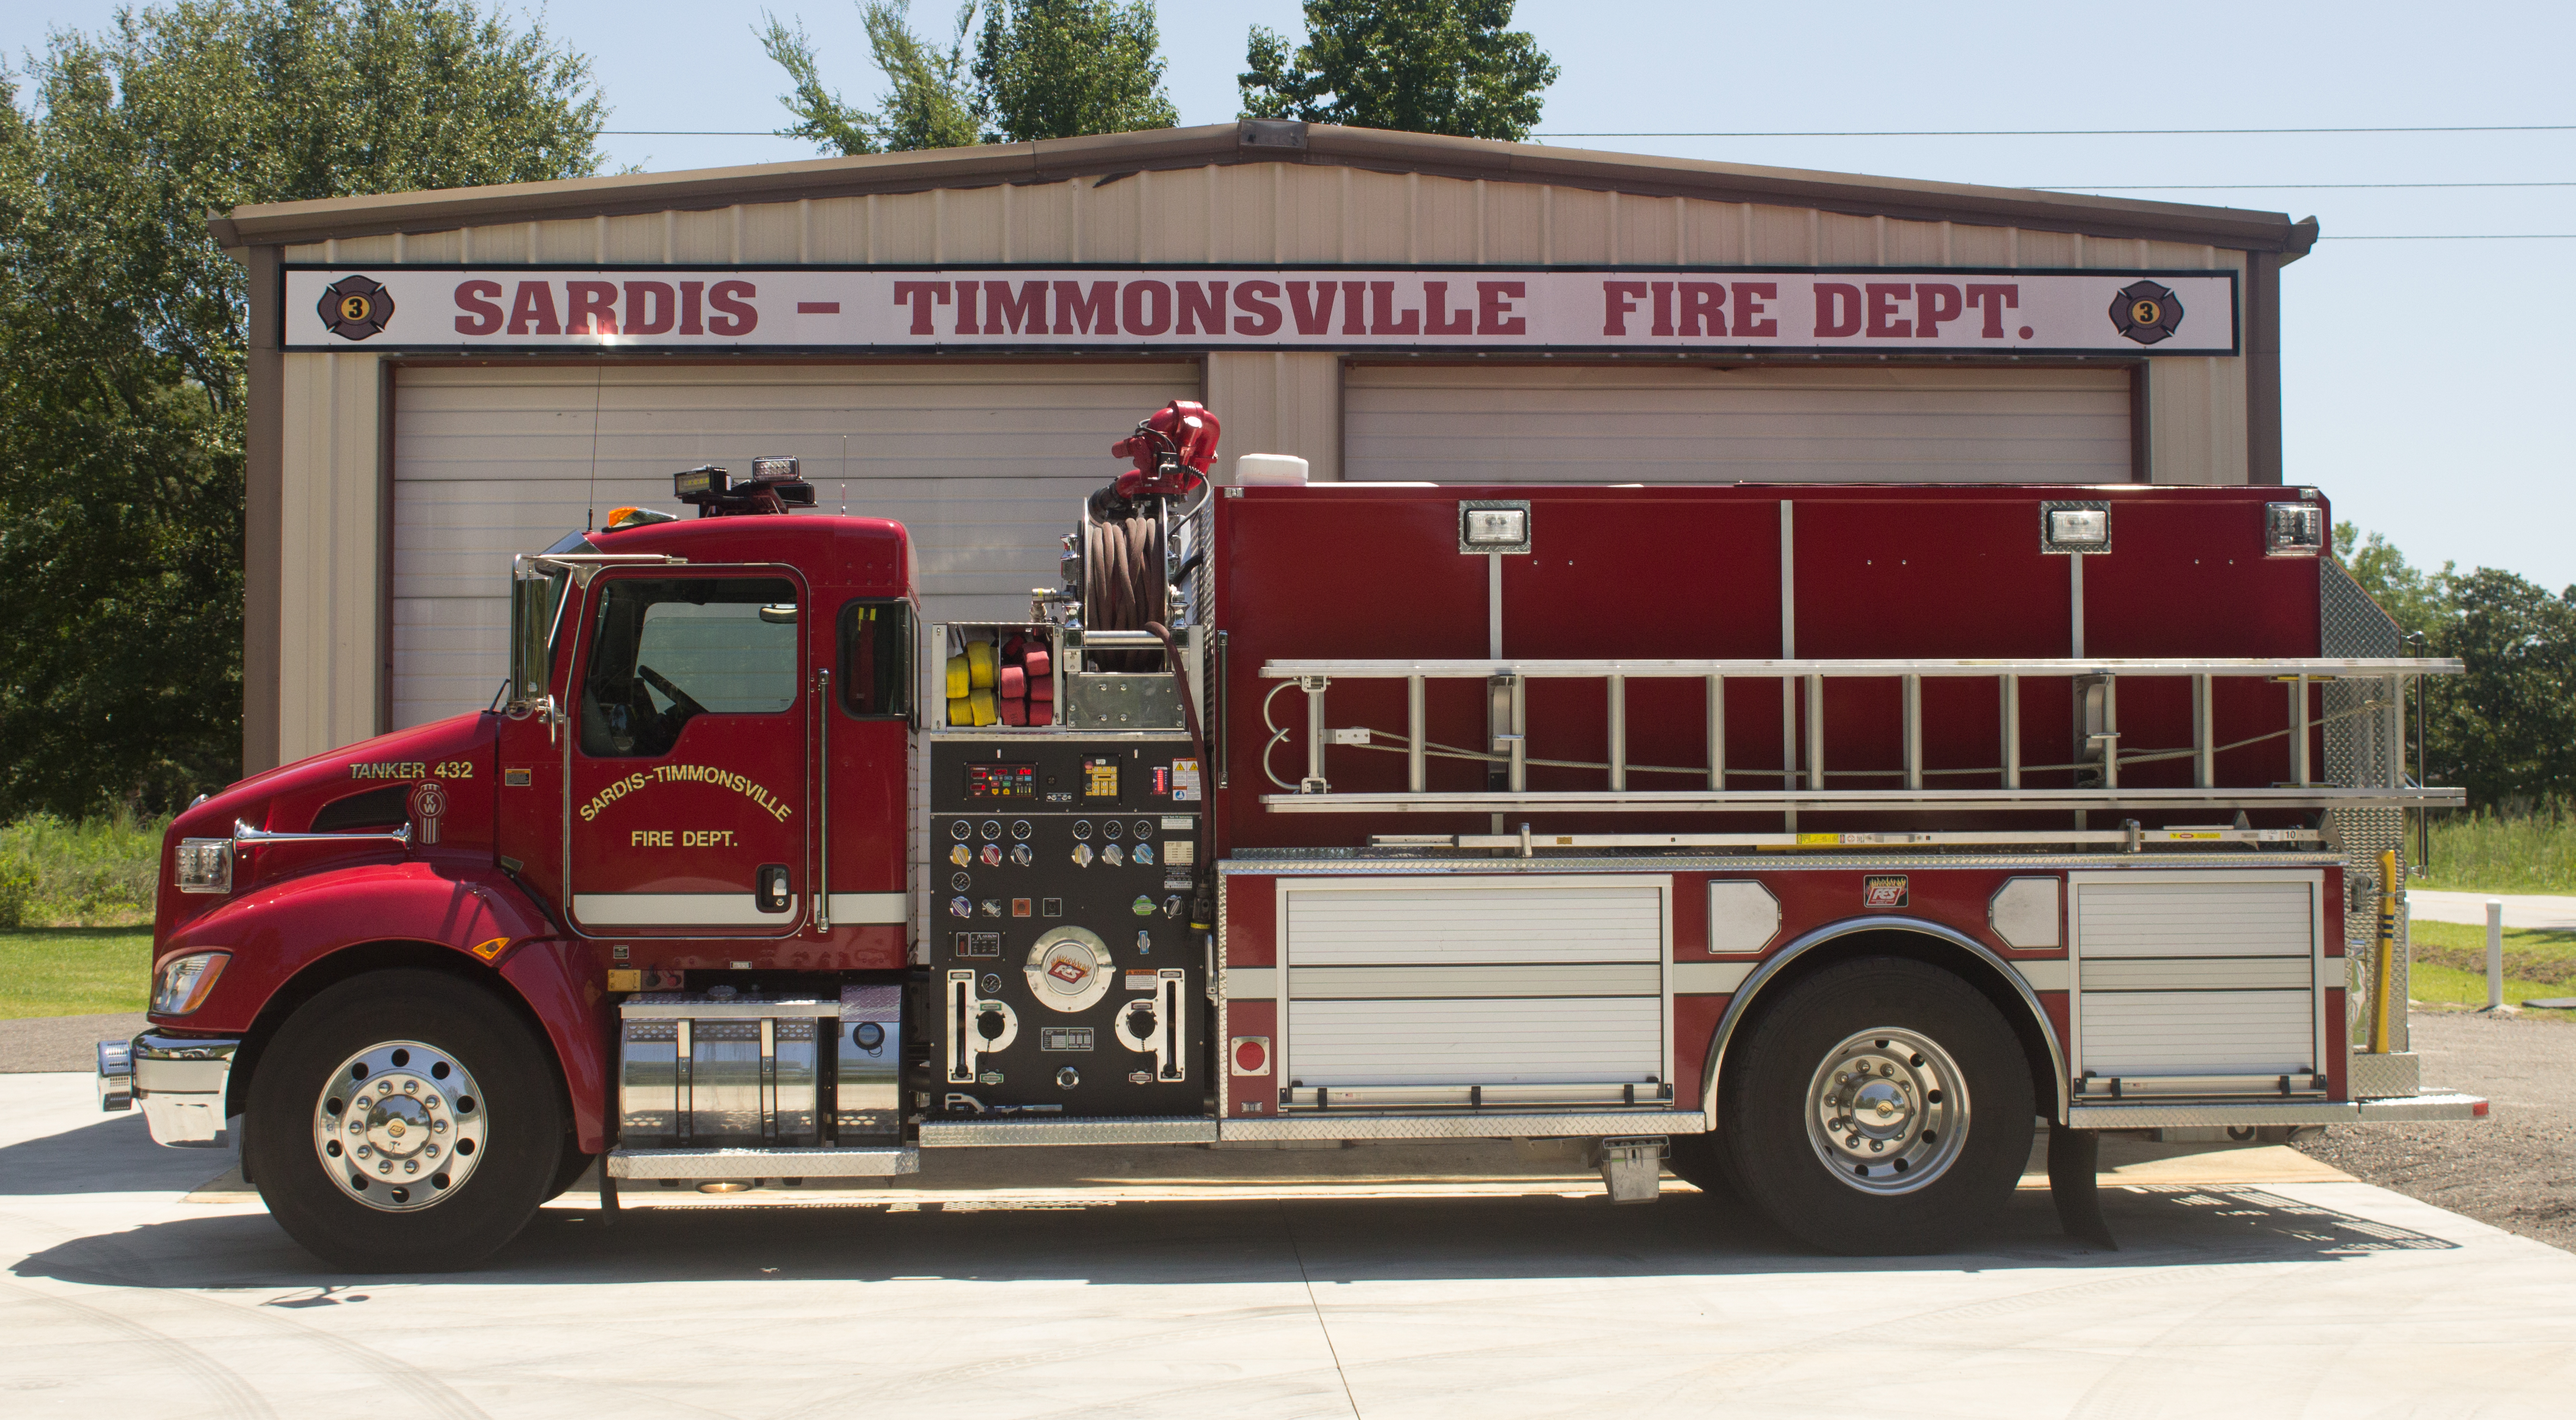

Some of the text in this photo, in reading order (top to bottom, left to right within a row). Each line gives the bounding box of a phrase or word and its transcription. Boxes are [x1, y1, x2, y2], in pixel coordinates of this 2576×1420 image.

[349, 298, 363, 319] 3
[454, 280, 758, 336] SARDIS
[894, 280, 1526, 337] TIMMONSVILLE
[1603, 281, 1778, 337] FIRE
[1813, 283, 2035, 340] DEPT.
[2139, 302, 2154, 323] 3
[350, 761, 473, 778] TANKER 432
[426, 795, 435, 804] K
[579, 765, 792, 822] SARDIS-TIMMONSVILLE
[423, 803, 437, 813] W
[631, 831, 738, 846] FIRE DEPT.
[2286, 831, 2296, 839] 10
